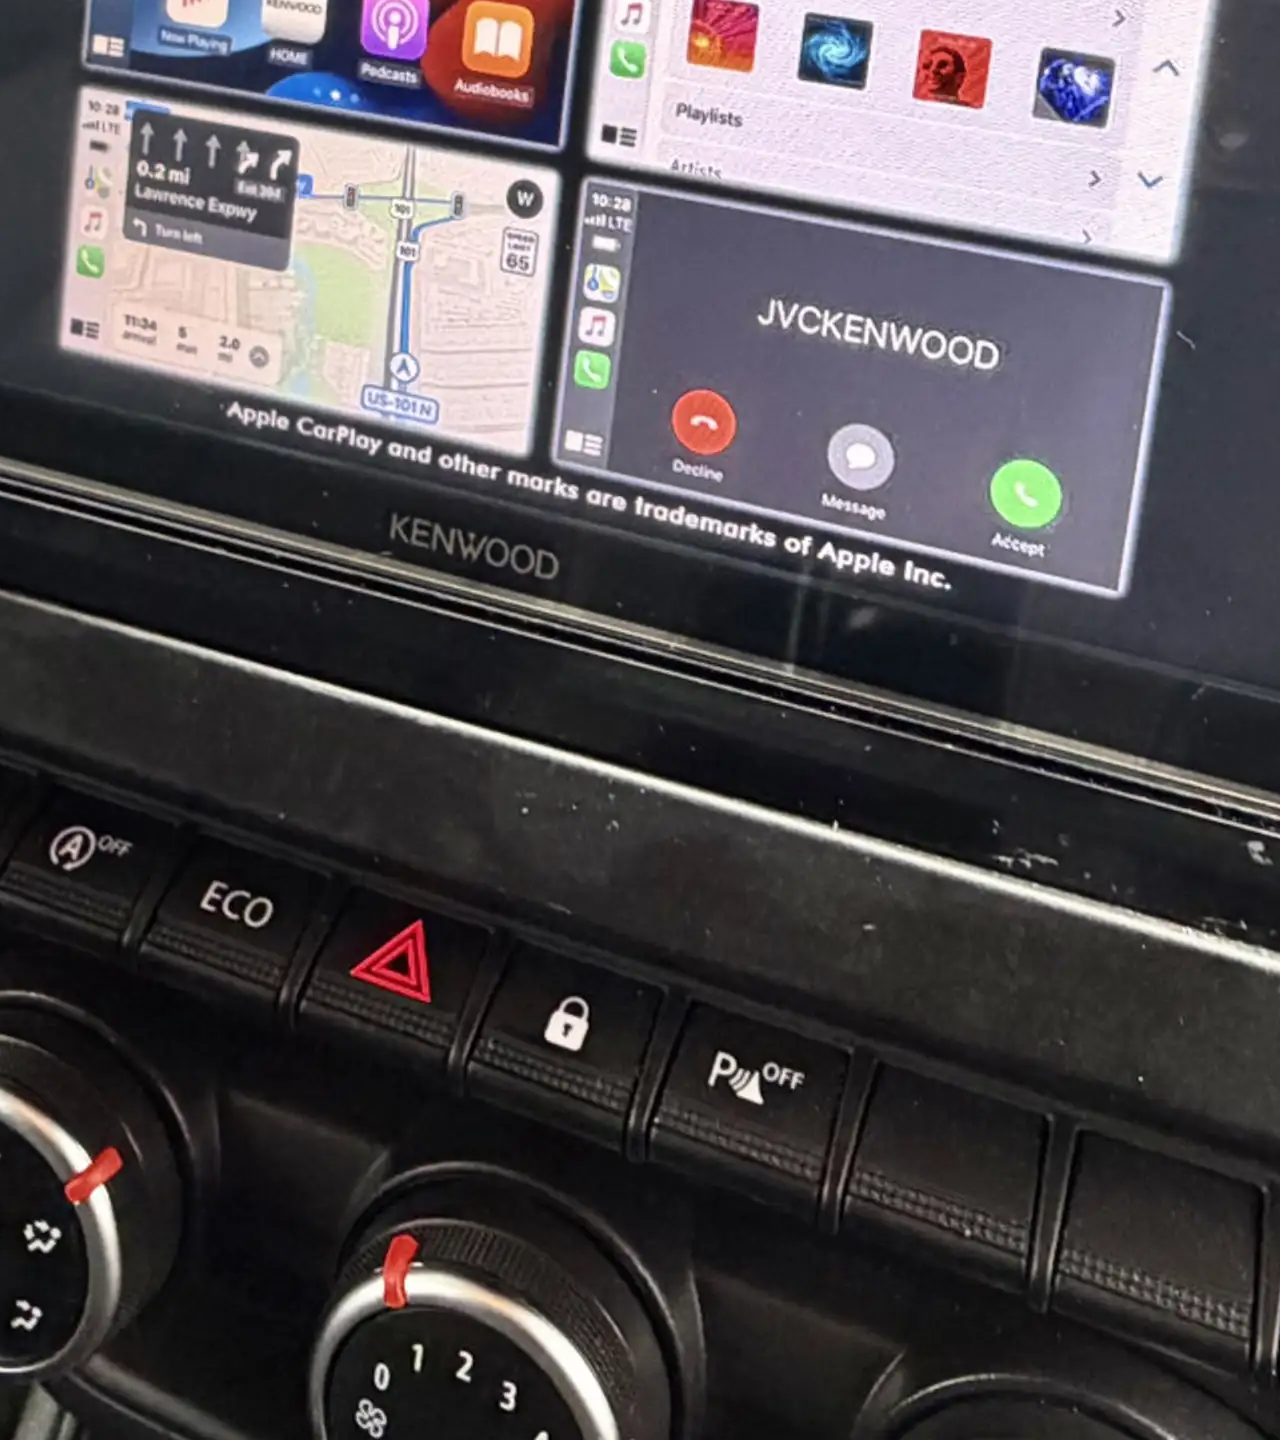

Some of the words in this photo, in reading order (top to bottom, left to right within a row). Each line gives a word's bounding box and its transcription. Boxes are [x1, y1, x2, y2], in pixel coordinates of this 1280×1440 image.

[188, 34, 228, 55] Playing
[271, 47, 308, 66] HOME
[361, 61, 418, 84] Podcasts
[454, 78, 531, 104] Audiobooks
[101, 121, 121, 135] LTE
[676, 102, 743, 128] Playlists
[136, 160, 167, 178] 0.2
[169, 165, 191, 186] mi
[134, 182, 206, 211] Lawrence
[207, 197, 258, 223] Expwy
[517, 189, 535, 208] W
[591, 192, 632, 212] 10:28
[154, 223, 181, 240] Turn
[182, 228, 204, 245] left
[608, 216, 632, 233] LTE
[399, 245, 417, 259] 101
[506, 254, 531, 273] 65
[219, 335, 241, 351] 2.0
[757, 299, 999, 370] JVCKENWOOD
[368, 391, 418, 413] US-101
[418, 402, 433, 417] N
[672, 458, 724, 482] Decline
[226, 401, 290, 431] Apple
[296, 415, 383, 457] CarPlay
[388, 437, 432, 464] and
[438, 453, 502, 480] other
[507, 468, 580, 500] marks
[586, 488, 628, 511] are
[635, 496, 777, 548] trademarks
[784, 534, 813, 557] of
[818, 540, 897, 578] Apple
[904, 560, 953, 591] Inc.
[821, 492, 887, 521] Message
[389, 512, 561, 581] KENWOOD
[991, 532, 1046, 558] Accept
[97, 834, 134, 857] OFF
[200, 879, 274, 929] ECO
[707, 1050, 737, 1088] P
[762, 1061, 806, 1091] OFF
[411, 1343, 424, 1373] 1
[456, 1350, 474, 1383] 2
[373, 1362, 391, 1391] 0
[499, 1380, 518, 1412] 3
